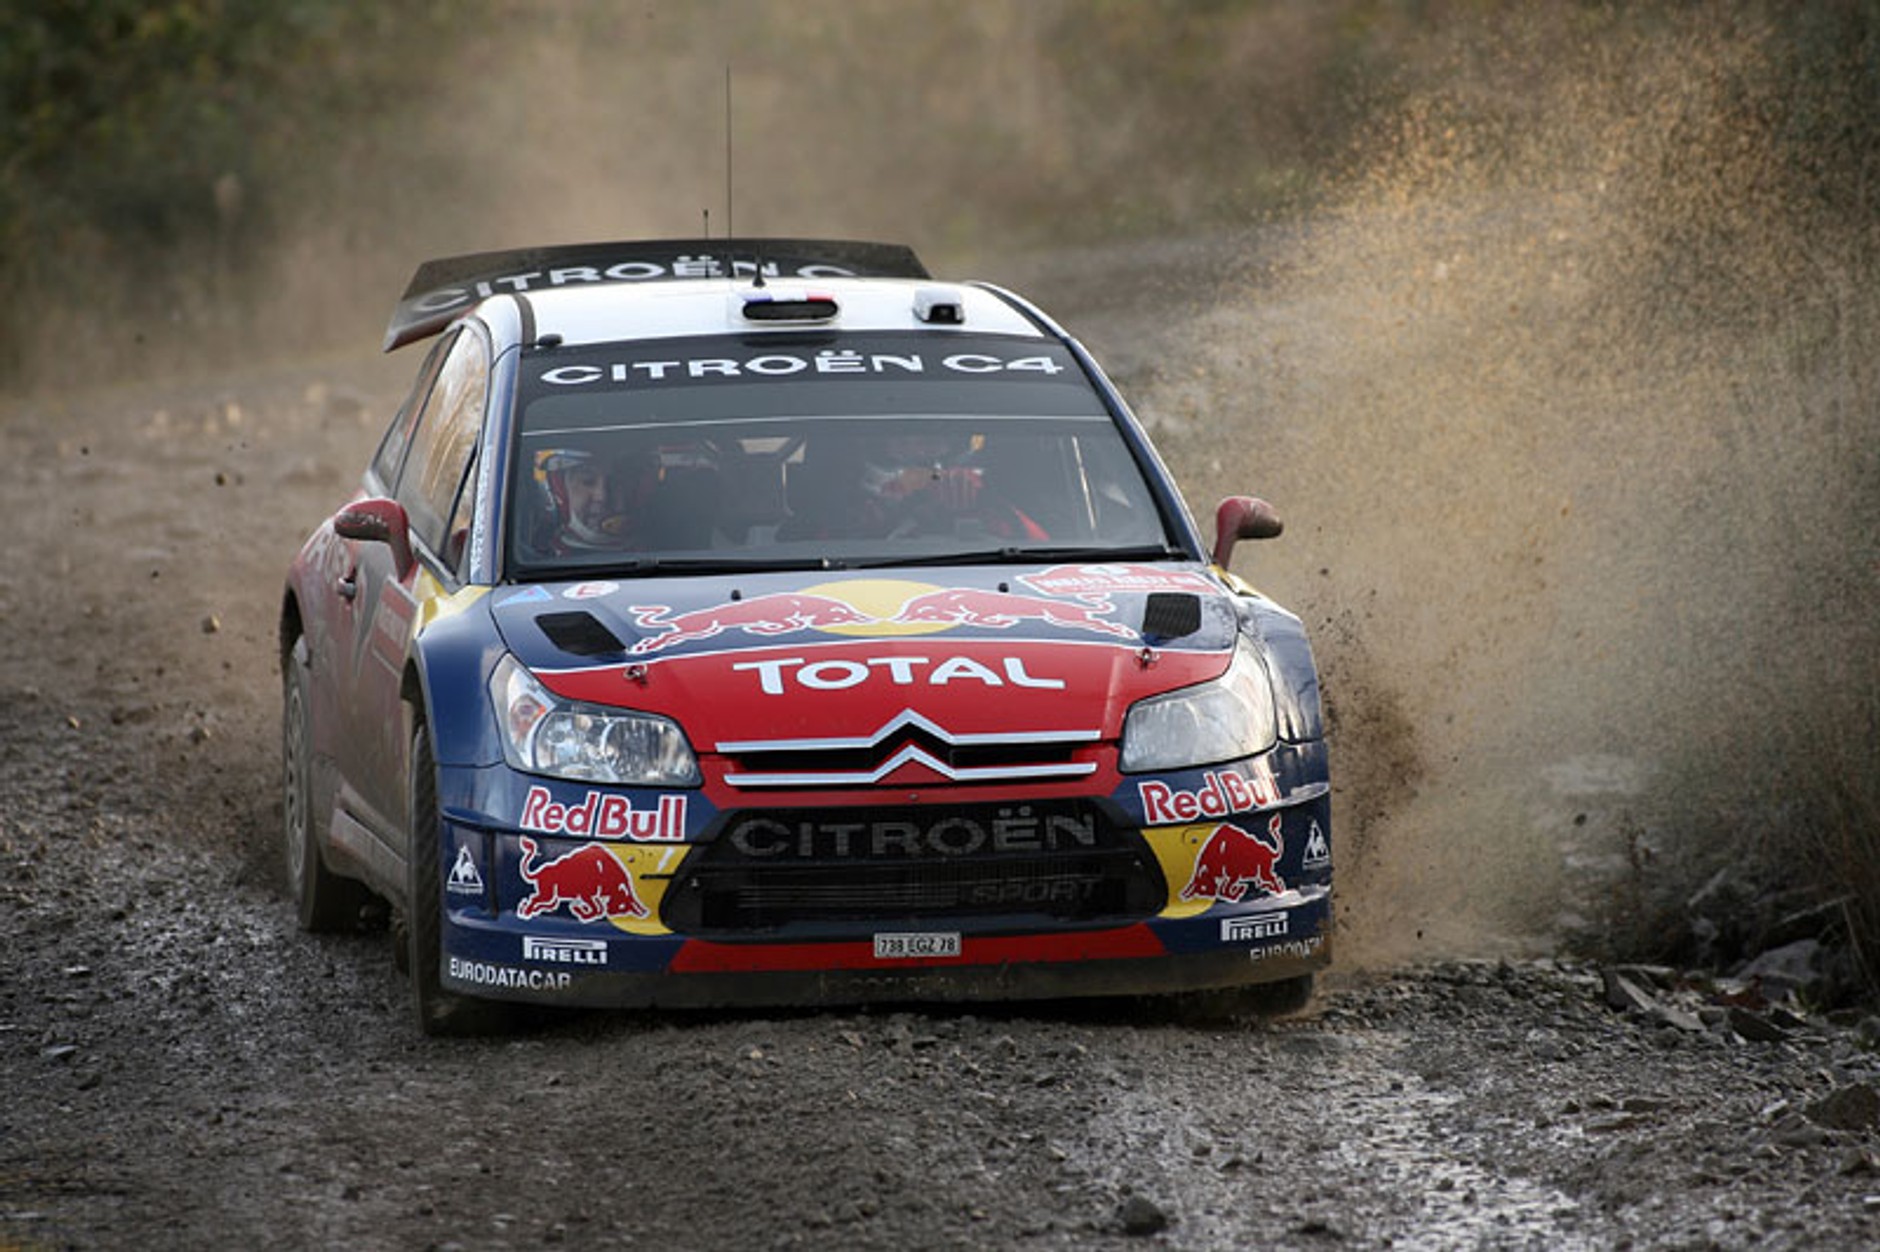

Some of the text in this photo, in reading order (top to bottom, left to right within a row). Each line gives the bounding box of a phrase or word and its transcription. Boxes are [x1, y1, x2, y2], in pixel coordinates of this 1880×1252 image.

[540, 350, 1065, 386] CITROËN C4
[732, 656, 1065, 695] TOTAL
[519, 785, 688, 841] Red Bull
[1138, 772, 1229, 826] Red
[730, 805, 1097, 858] CITROËN
[1220, 911, 1289, 942] PIRELLI
[522, 935, 608, 965] PIRELLI
